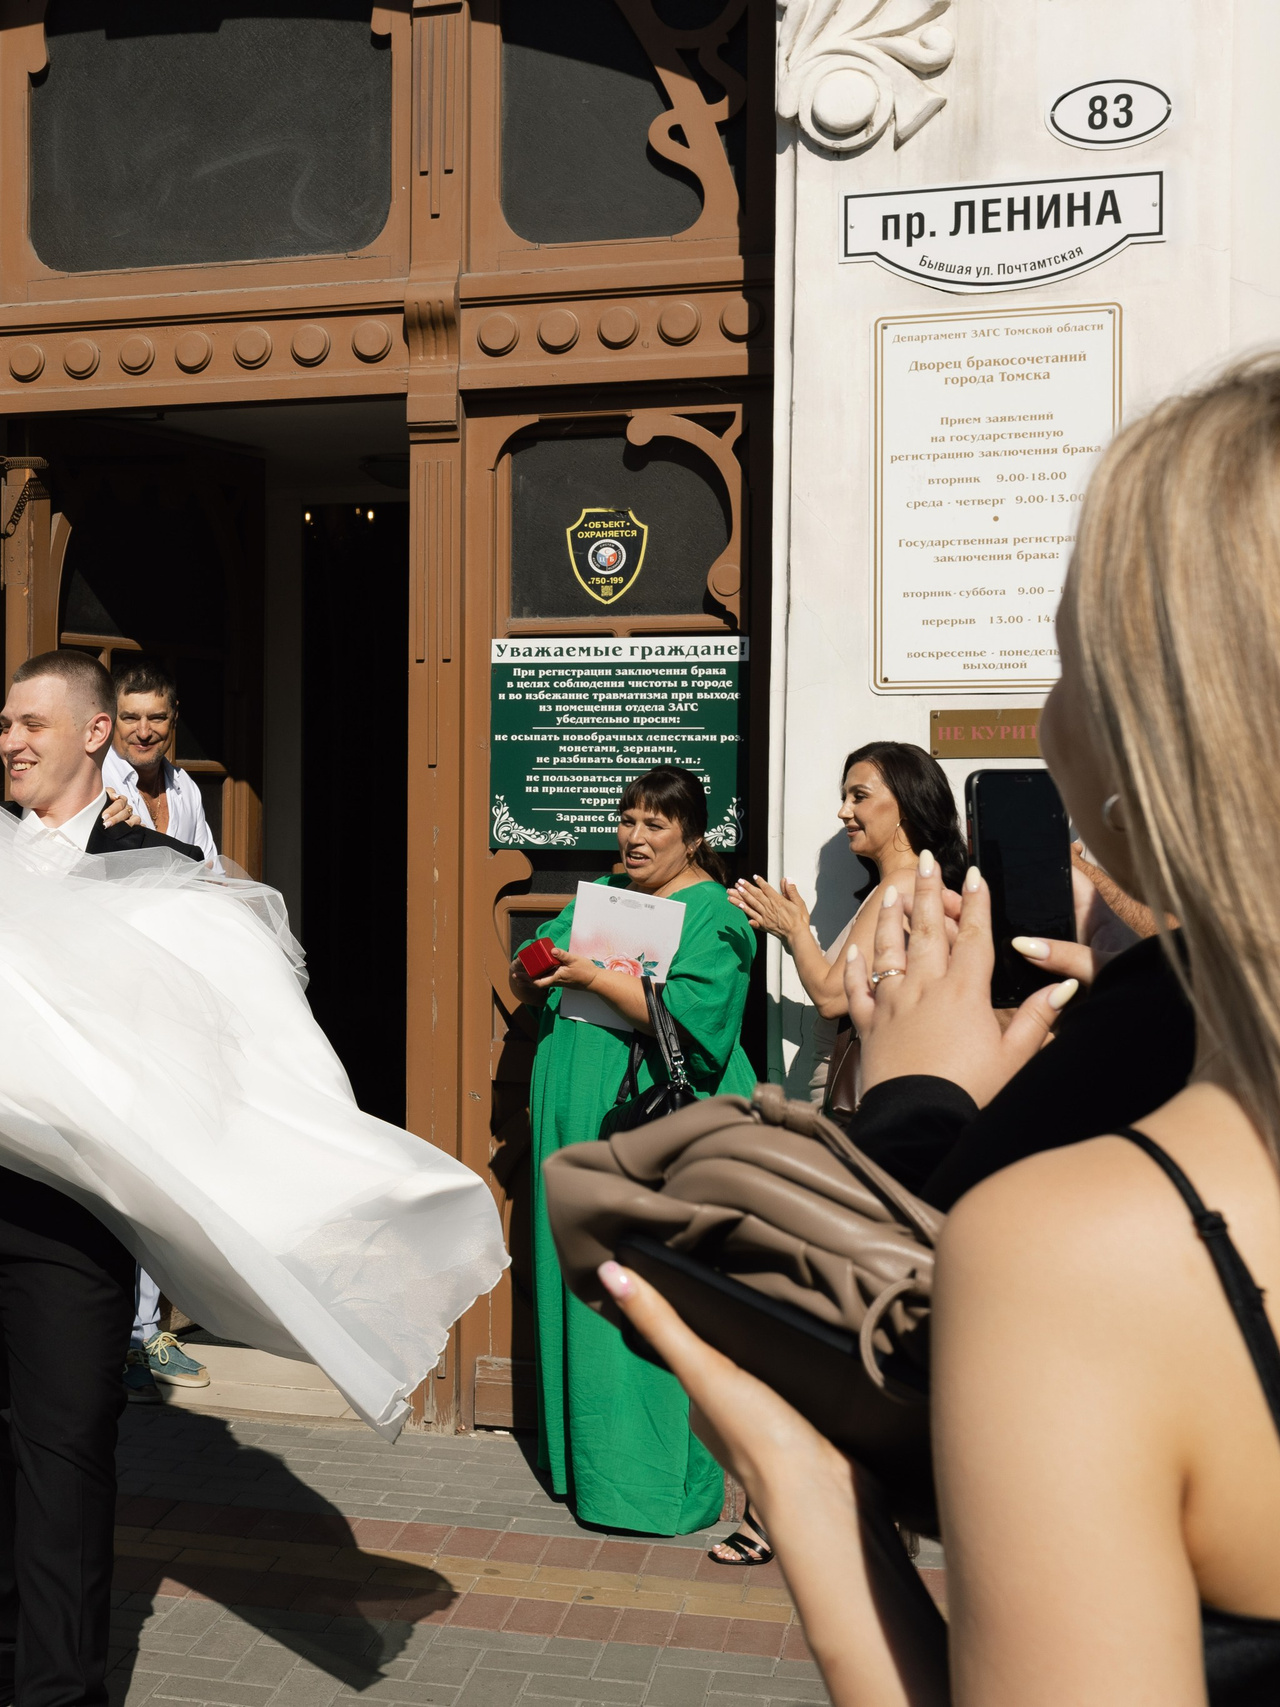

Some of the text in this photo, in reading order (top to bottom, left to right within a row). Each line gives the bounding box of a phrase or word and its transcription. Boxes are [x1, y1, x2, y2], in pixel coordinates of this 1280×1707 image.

[1088, 94, 1133, 130] 83
[882, 190, 1122, 247] пр. ЛЕНИНА
[918, 247, 1085, 278] Бывшая ул. Почтамтская
[892, 323, 1103, 343] Департамент ЗАГС Томской области
[908, 351, 1086, 372] Дворец бракосочетаний
[945, 372, 1050, 387] города Томска
[941, 412, 1053, 427] Прием заявлений
[931, 430, 1063, 443] на государственную
[891, 452, 974, 463] регистрацию
[979, 448, 1057, 457] заключения
[928, 472, 1066, 486] вторник 9.00-18.00
[906, 500, 942, 509] среда
[956, 498, 1005, 507] четверг
[589, 520, 625, 529] ОБЪЕКТ
[578, 530, 637, 538] ОХРАНЯЕТСЯ
[899, 538, 1008, 549] Государственная
[933, 551, 1059, 562] заключения брака:
[1018, 587, 1044, 595] 9.00
[922, 619, 976, 627] перерыв
[496, 641, 746, 660] Уважаемые граждане!
[907, 651, 986, 660] воскресенье
[963, 661, 1027, 670] выходной
[513, 665, 726, 678] При регистрации заключения брака
[506, 679, 732, 689] в целях соблюдения чистоты в городе
[509, 692, 522, 700] во
[526, 690, 589, 700] избежание
[592, 693, 668, 701] травматизма
[671, 693, 693, 701] при
[697, 692, 741, 701] выходе
[539, 703, 698, 713] из помещения отдела ЗАГС
[556, 714, 680, 725] убедительно просим:
[495, 734, 508, 742] не
[511, 734, 560, 742] осыпать
[563, 732, 643, 743] новобрачных
[646, 734, 717, 742] лепестками
[936, 724, 1037, 742] НЕ КУРИТ
[559, 745, 676, 754] монетами, зернами,
[537, 756, 550, 764] не
[553, 754, 613, 765] разбивать
[616, 754, 661, 763] бокалы
[526, 774, 539, 782] не
[543, 775, 622, 783] пользоваться
[526, 785, 623, 794] на прилегающей
[580, 796, 620, 806] террит
[556, 813, 604, 823] Заранее
[574, 825, 587, 833] за
